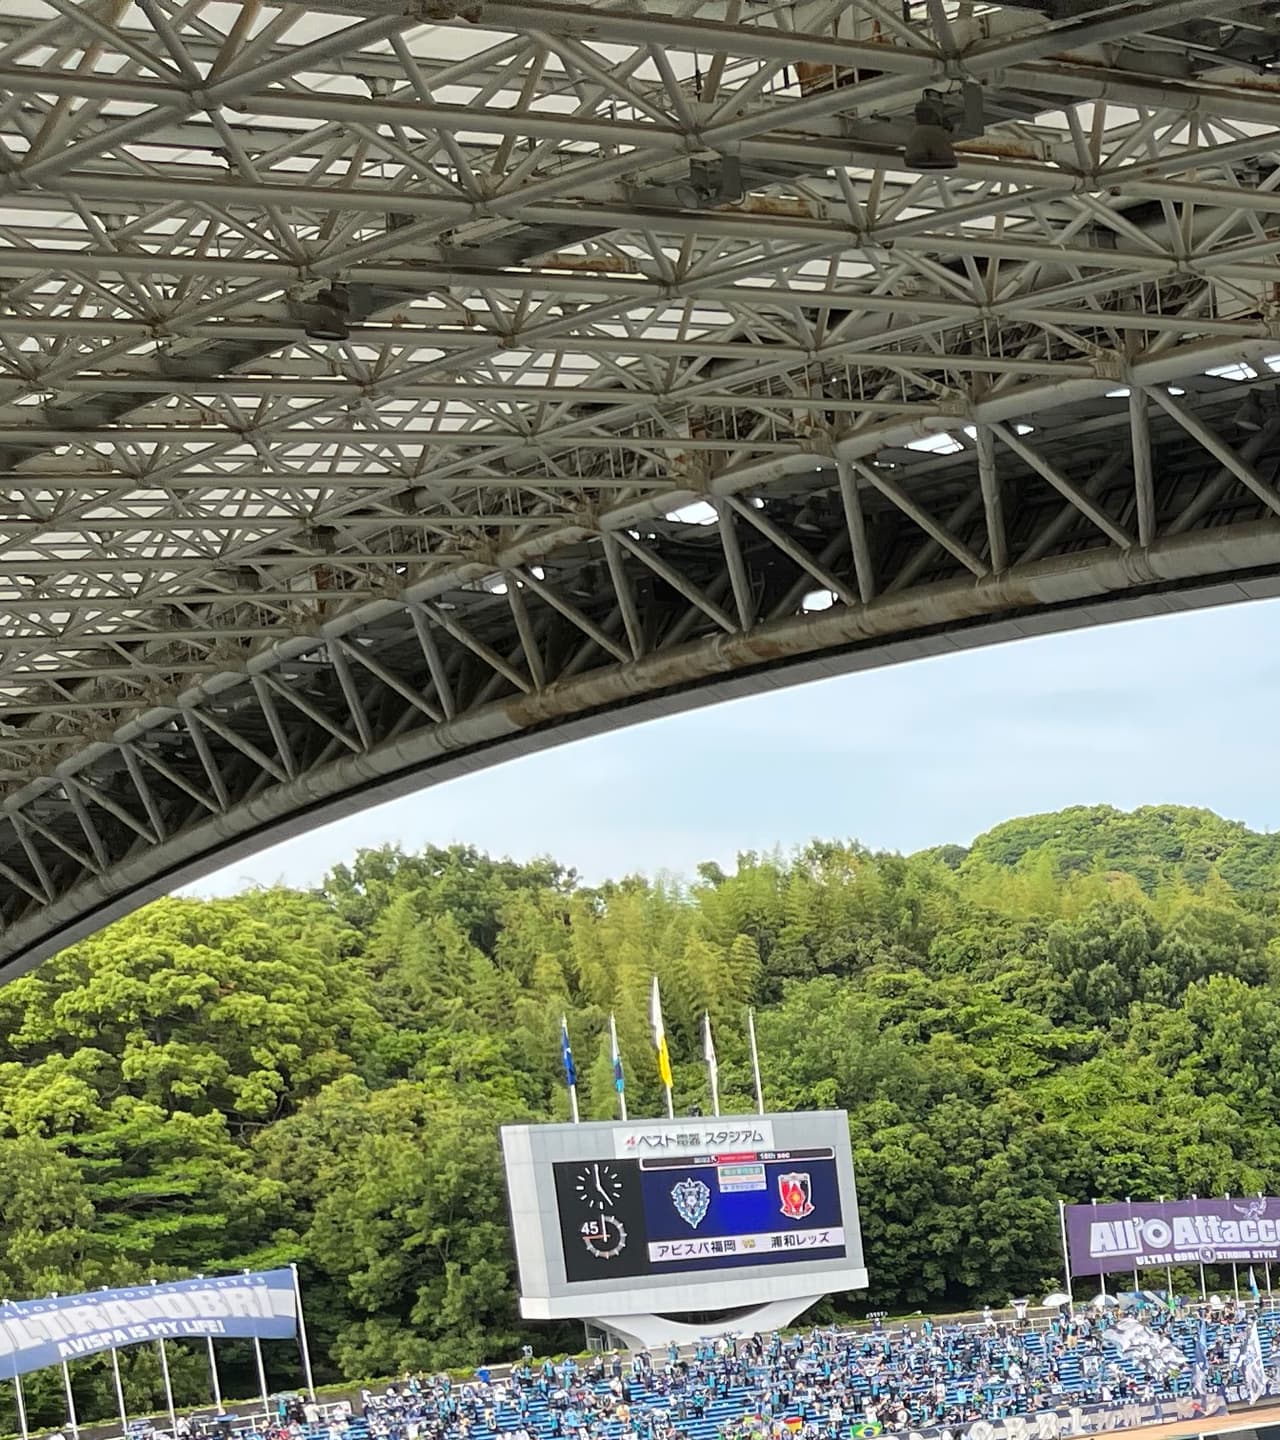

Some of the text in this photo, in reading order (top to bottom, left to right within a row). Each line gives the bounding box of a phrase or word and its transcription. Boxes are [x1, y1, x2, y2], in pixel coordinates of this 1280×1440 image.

[581, 1222, 598, 1235] 45
[656, 1238, 736, 1256] アビスパ福岡
[771, 1232, 830, 1249] 浦和レッズ
[190, 1276, 266, 1291] PARTES
[56, 1319, 226, 1357] AVISPA IS MY LIFE!
